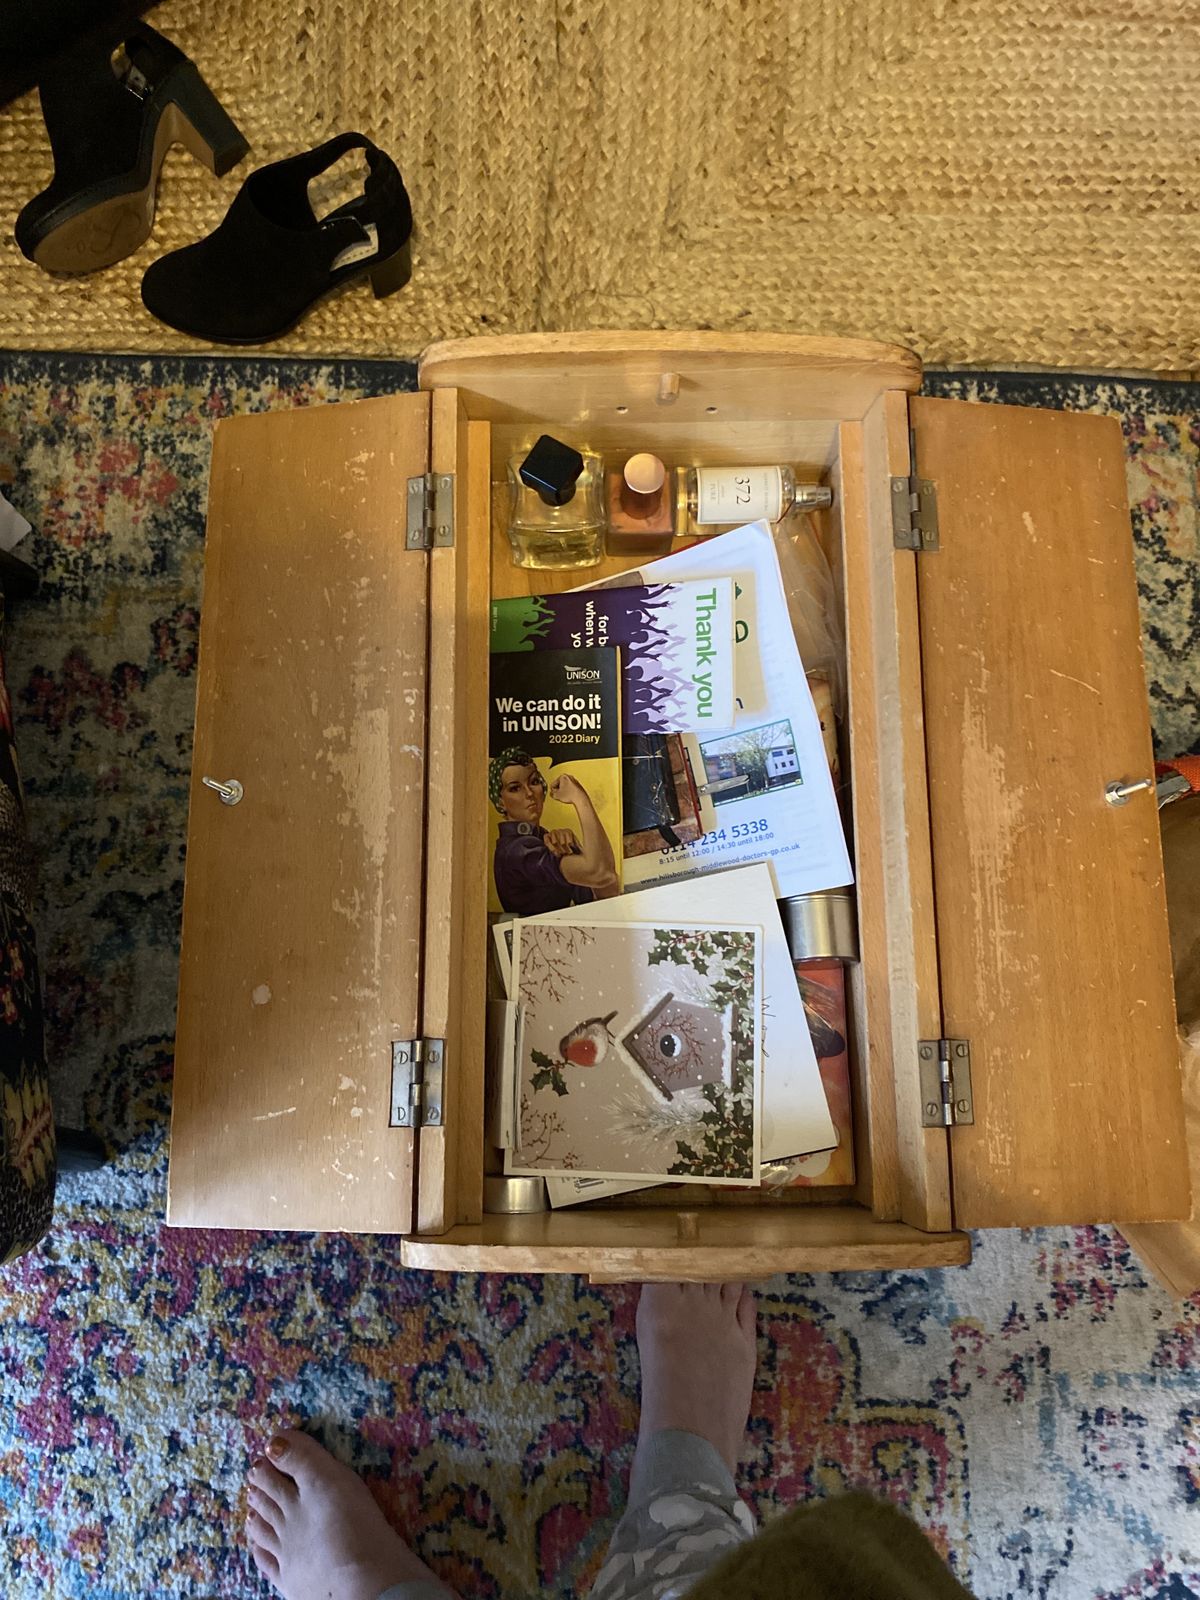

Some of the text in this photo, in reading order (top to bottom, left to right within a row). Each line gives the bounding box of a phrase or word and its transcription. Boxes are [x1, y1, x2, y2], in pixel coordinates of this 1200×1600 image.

[735, 477, 751, 505] 372
[585, 601, 597, 635] when
[598, 615, 609, 647] for b
[692, 588, 717, 718] Thank you
[566, 669, 600, 680] UNISON
[495, 693, 601, 713] We can do it
[503, 713, 601, 732] in UNISON!
[549, 734, 600, 744] 2022 Diary
[701, 829, 726, 847] 234
[732, 818, 769, 839] 5338
[659, 857, 675, 865] 8:15
[676, 852, 691, 863] until
[692, 847, 710, 858] 12:00
[717, 840, 736, 852] 14:30
[738, 836, 753, 847] until
[755, 832, 775, 843] 18:00
